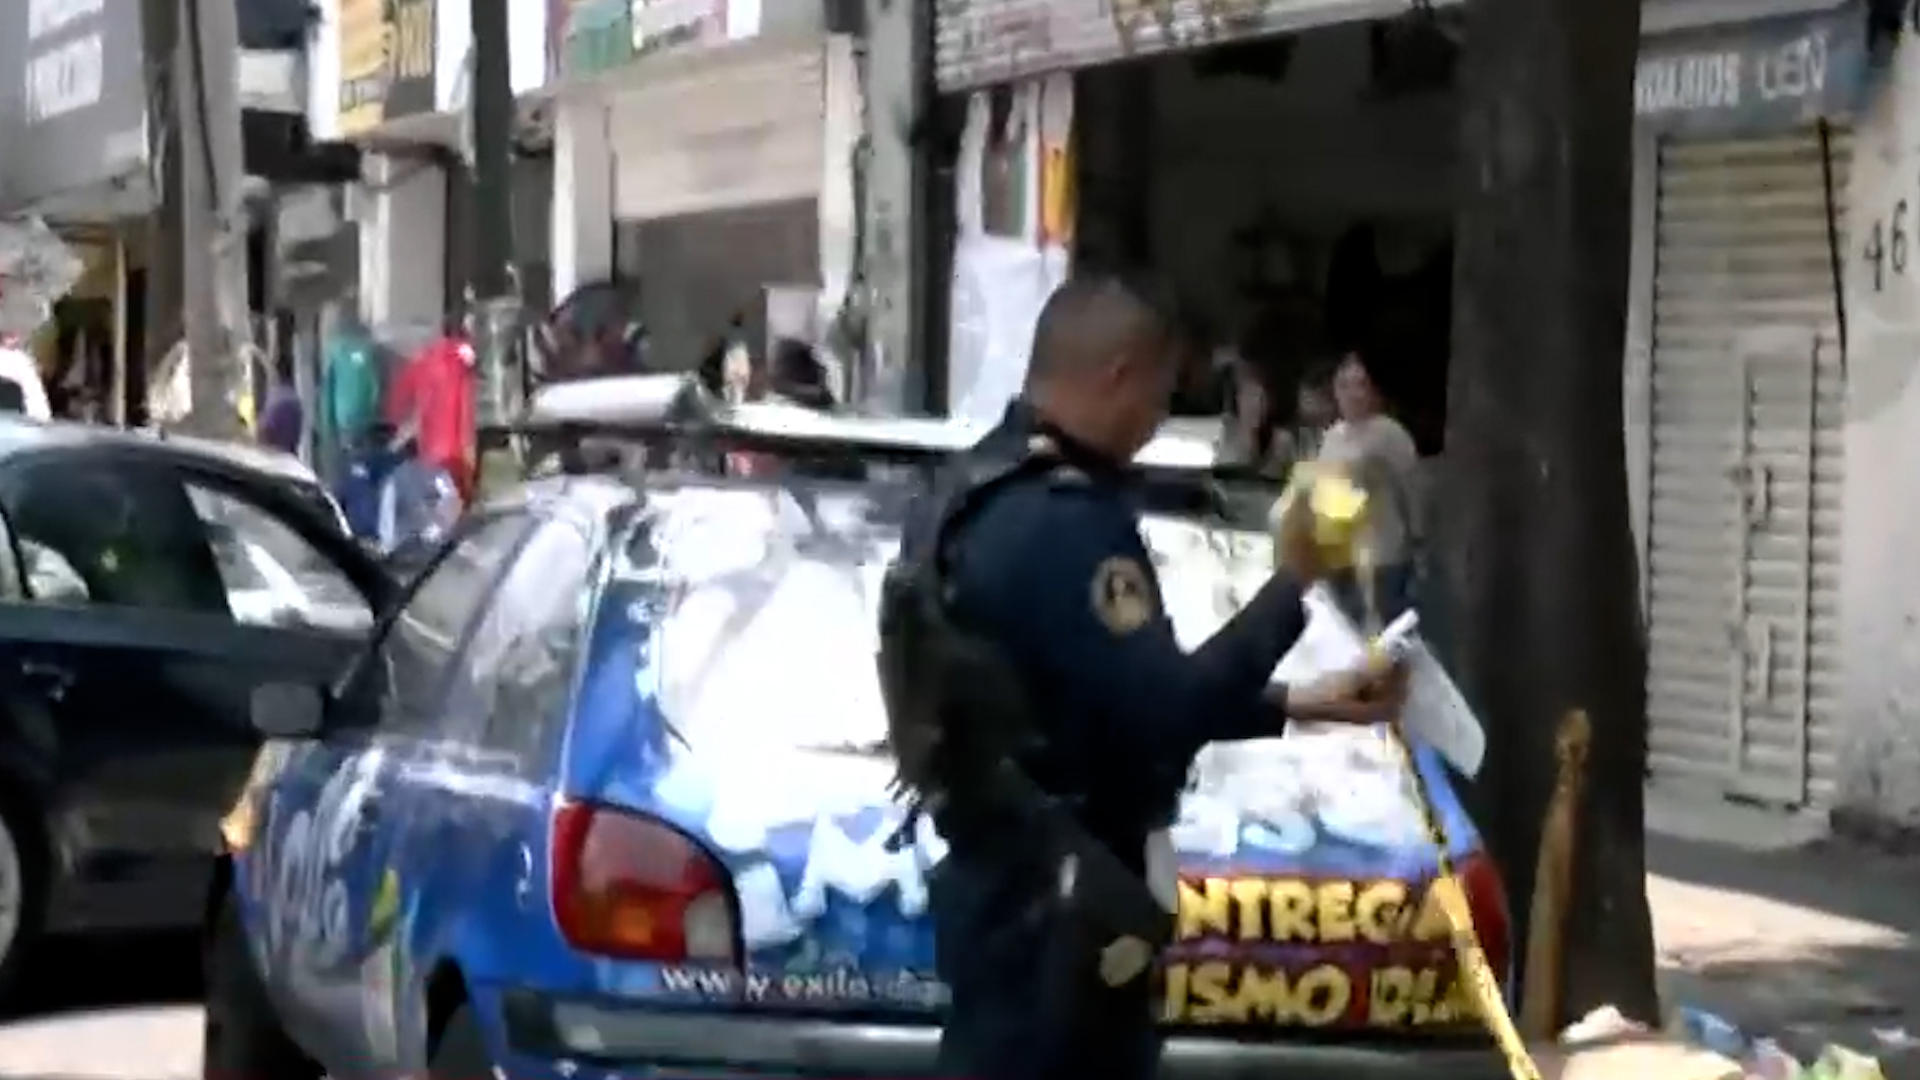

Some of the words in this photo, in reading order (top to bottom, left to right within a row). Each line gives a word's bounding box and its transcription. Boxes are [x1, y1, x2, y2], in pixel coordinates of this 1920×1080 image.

[1864, 198, 1912, 293] 46
[1176, 877, 1466, 943] NTREGA
[1163, 961, 1351, 1026] ISMO
